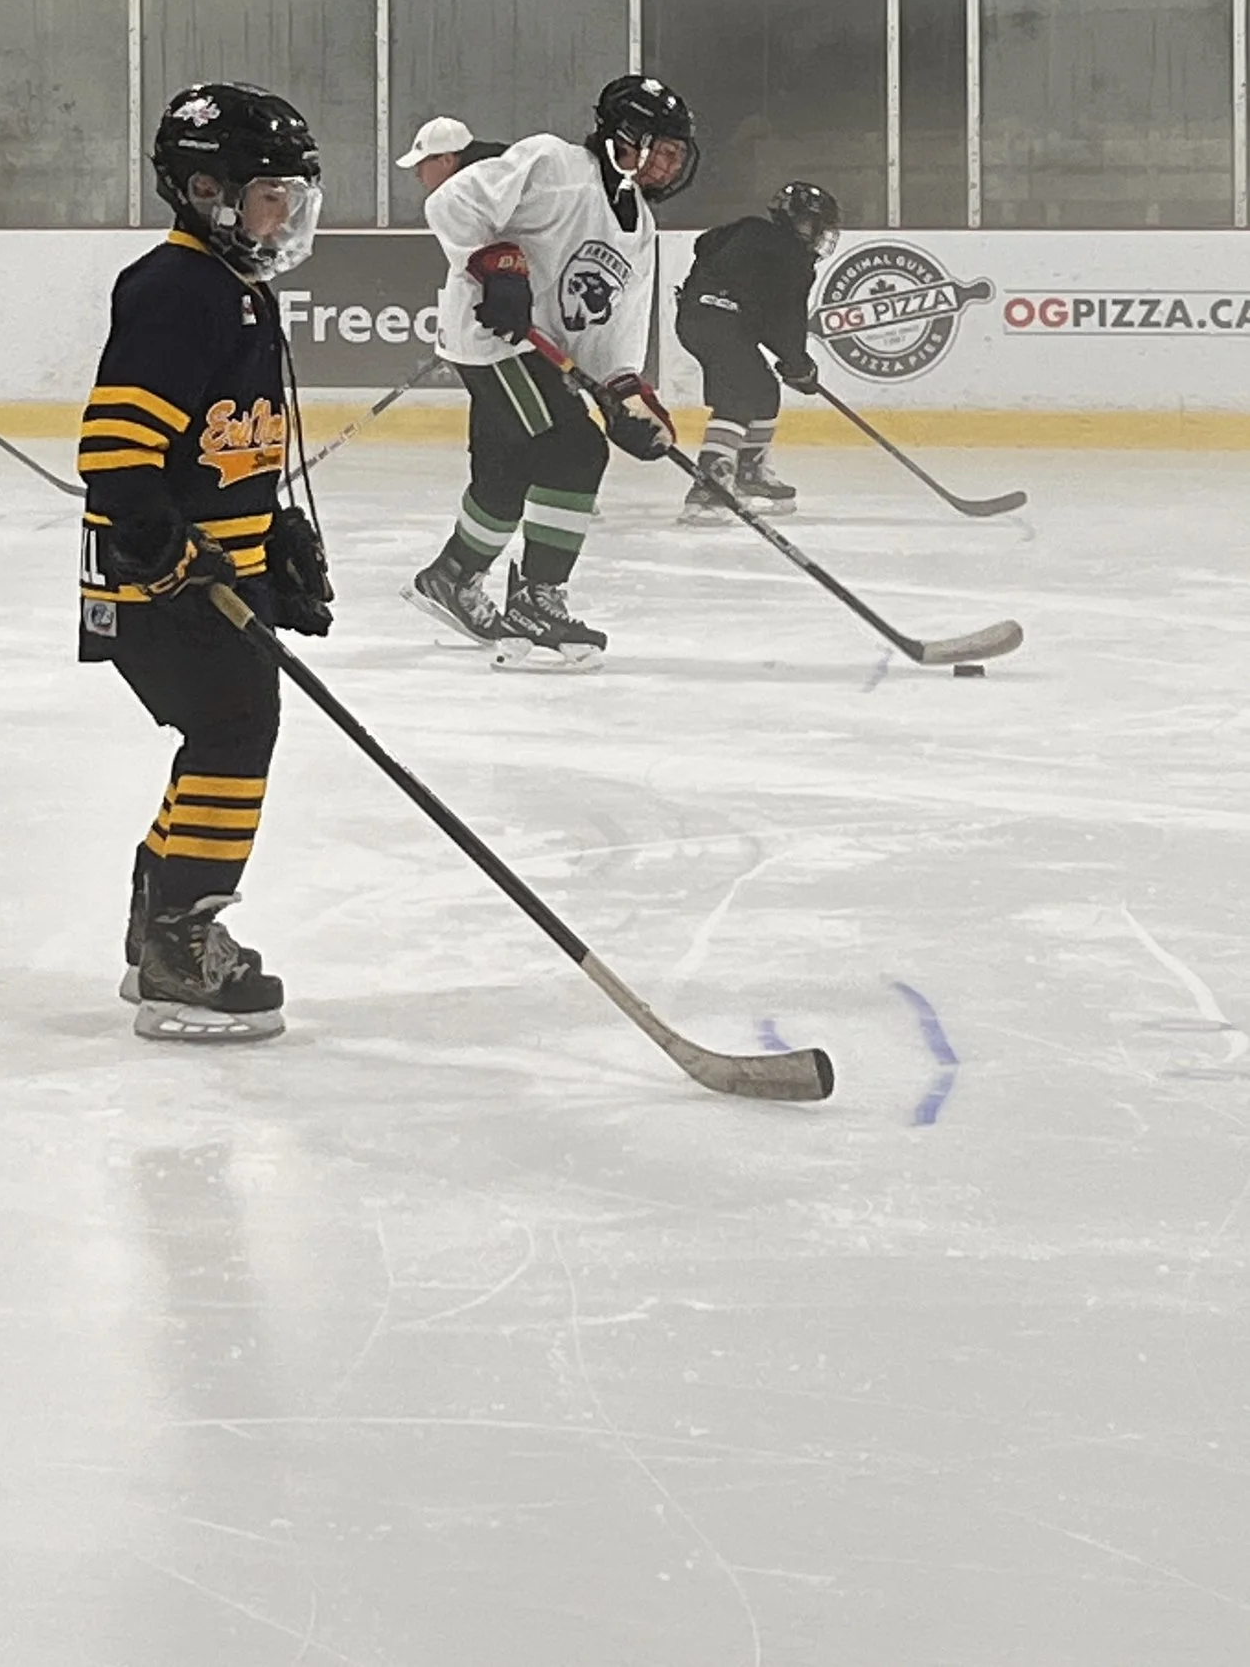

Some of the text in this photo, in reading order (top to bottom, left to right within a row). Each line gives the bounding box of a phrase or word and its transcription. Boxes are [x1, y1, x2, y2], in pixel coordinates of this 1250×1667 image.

[831, 254, 934, 301] ORIGINAL GUYS
[825, 289, 953, 332] OG PIZZA
[850, 348, 904, 372] PIZZA
